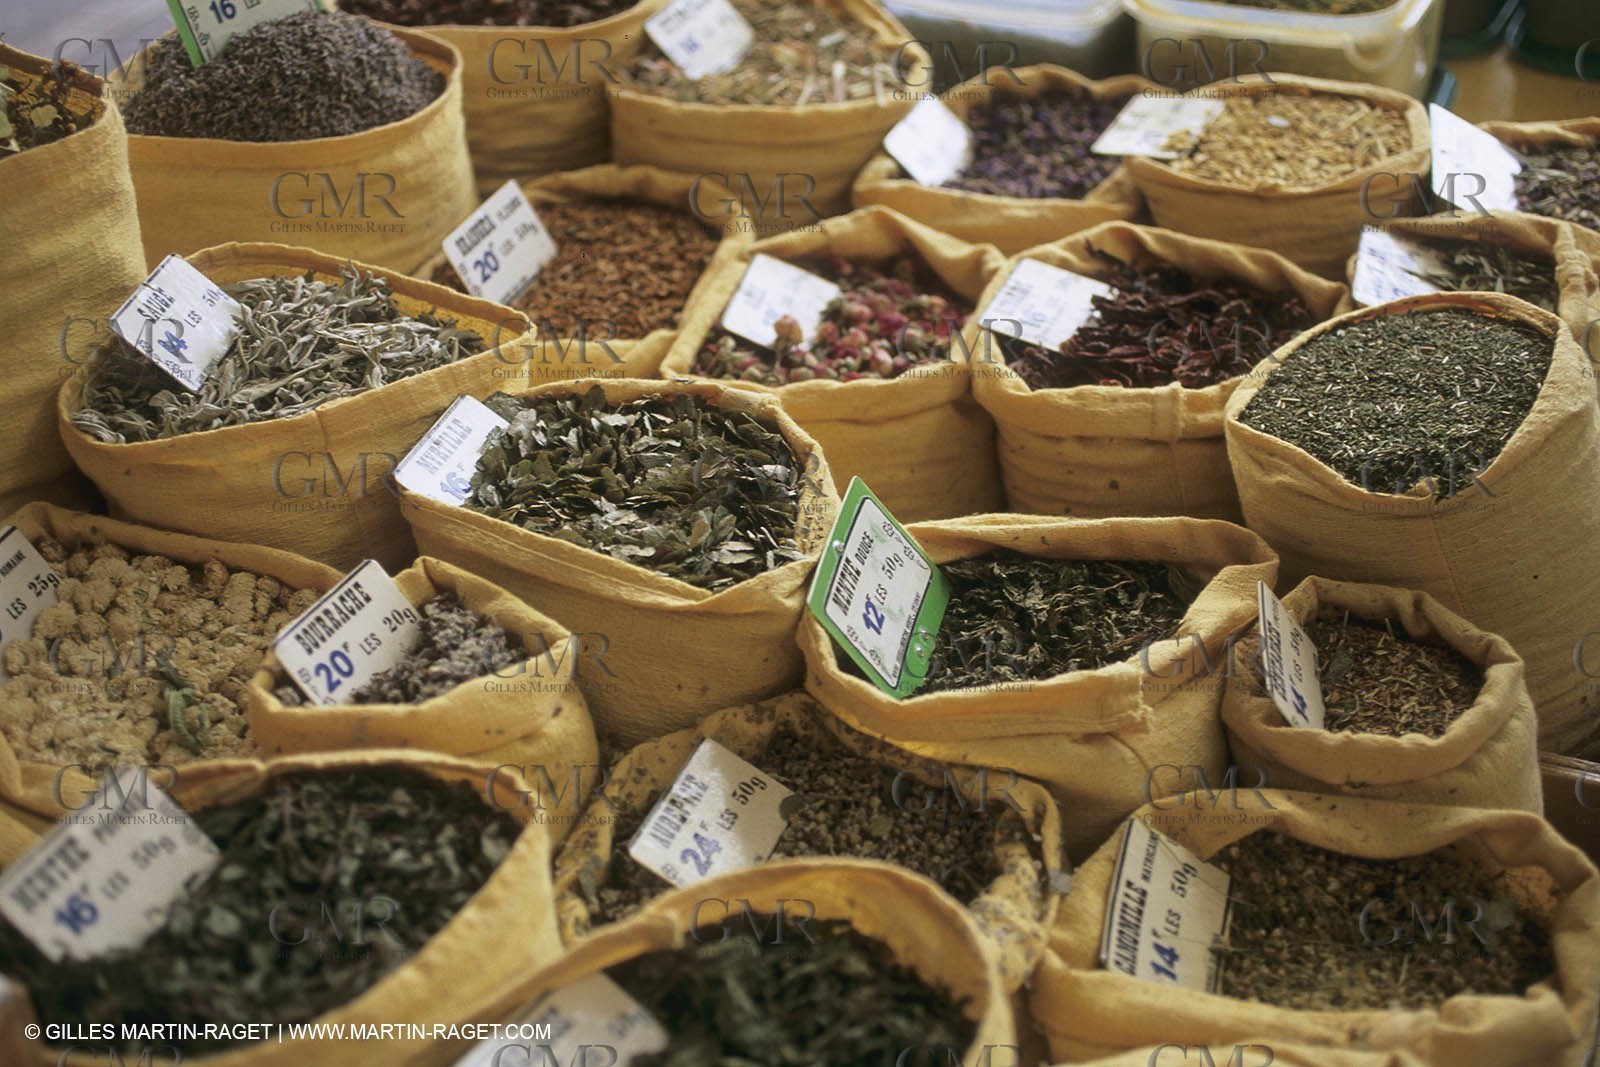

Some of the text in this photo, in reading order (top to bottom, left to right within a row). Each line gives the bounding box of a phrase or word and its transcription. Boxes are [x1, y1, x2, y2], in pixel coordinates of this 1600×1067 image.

[210, 0, 236, 24] 16
[473, 251, 499, 283] 20
[137, 287, 175, 324] SAUGE
[184, 310, 202, 328] LES
[440, 471, 472, 501] 16
[831, 530, 875, 617] MENTHE DOUCE
[862, 599, 885, 636] 12
[874, 583, 888, 607] LES
[881, 552, 905, 581] 50g
[6, 572, 60, 620] LES 25g
[294, 581, 372, 656] BOURRACHE
[314, 607, 417, 693] 20 F LES 20g
[680, 776, 768, 877] 24 F LES 50g
[1171, 862, 1199, 899] 50g
[54, 893, 99, 936] 16
[1114, 879, 1148, 977] CAMOMILLE
[1164, 908, 1182, 937] LES
[1151, 941, 1180, 982] 14
